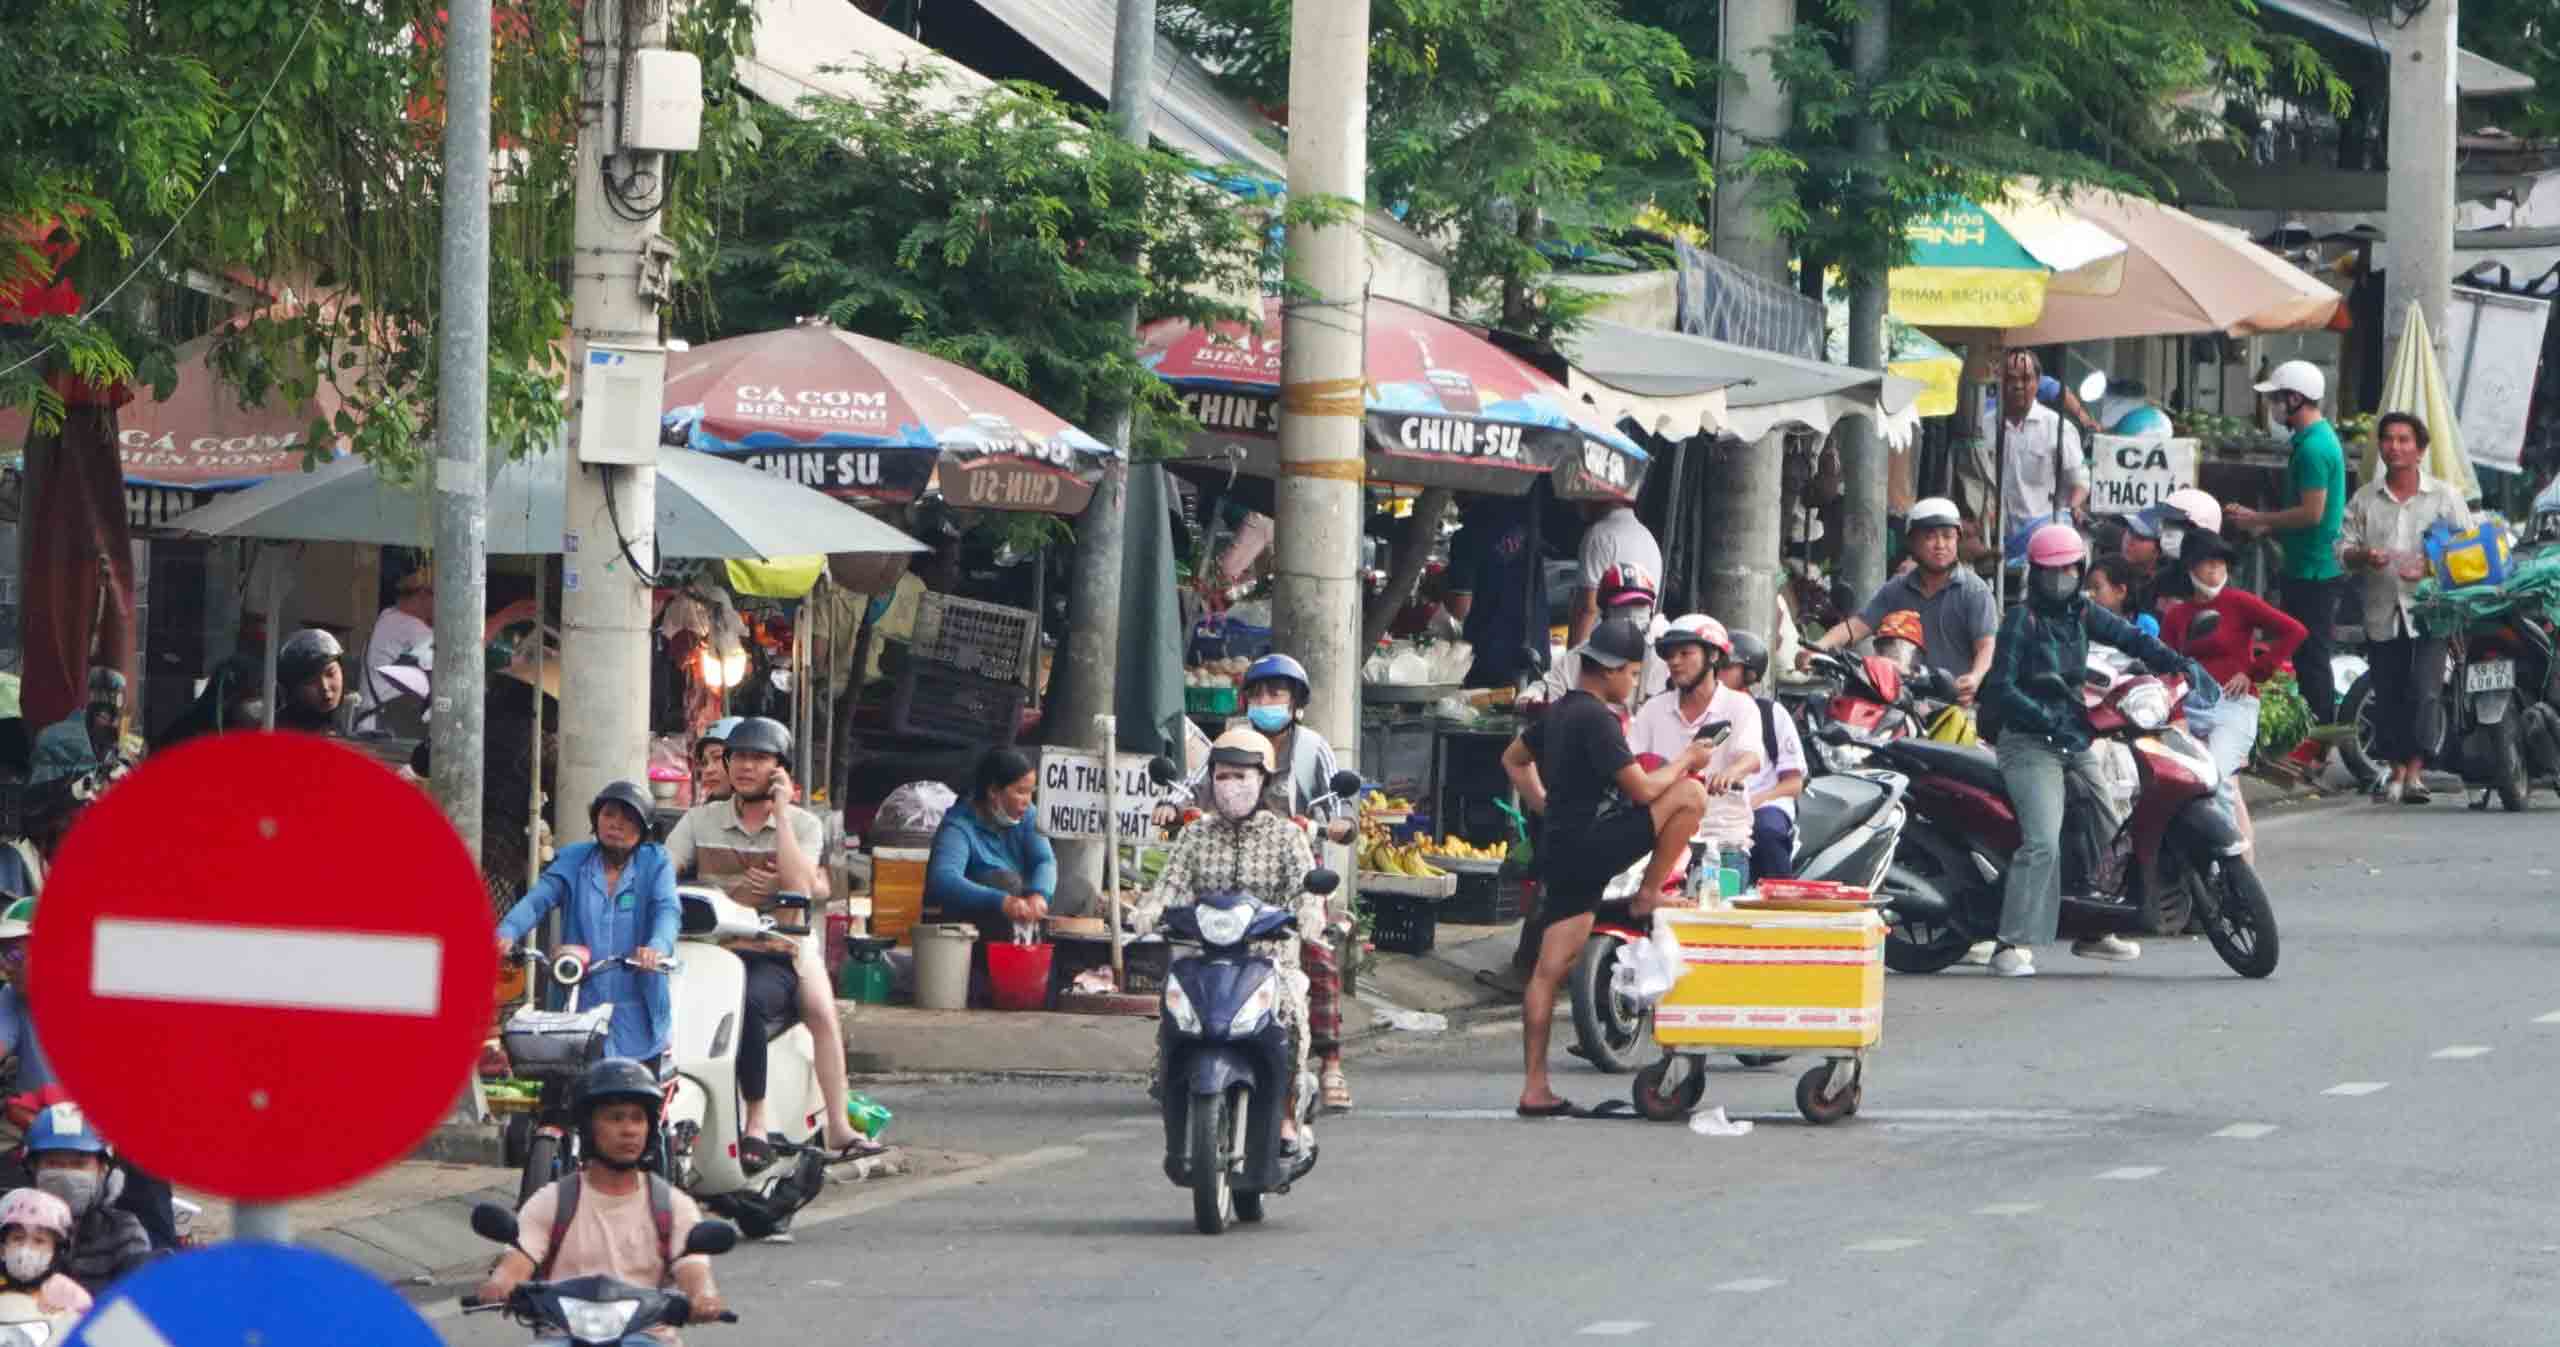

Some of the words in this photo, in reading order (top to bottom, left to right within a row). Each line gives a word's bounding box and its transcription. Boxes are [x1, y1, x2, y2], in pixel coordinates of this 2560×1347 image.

[1182, 392, 1280, 432] CHIN-S
[1401, 416, 1522, 458] CHIN-SU
[2116, 443, 2169, 470] CÁ
[2096, 475, 2147, 506] THÁC
[2154, 475, 2191, 505] LÁ
[1046, 758, 1068, 789] CÁ
